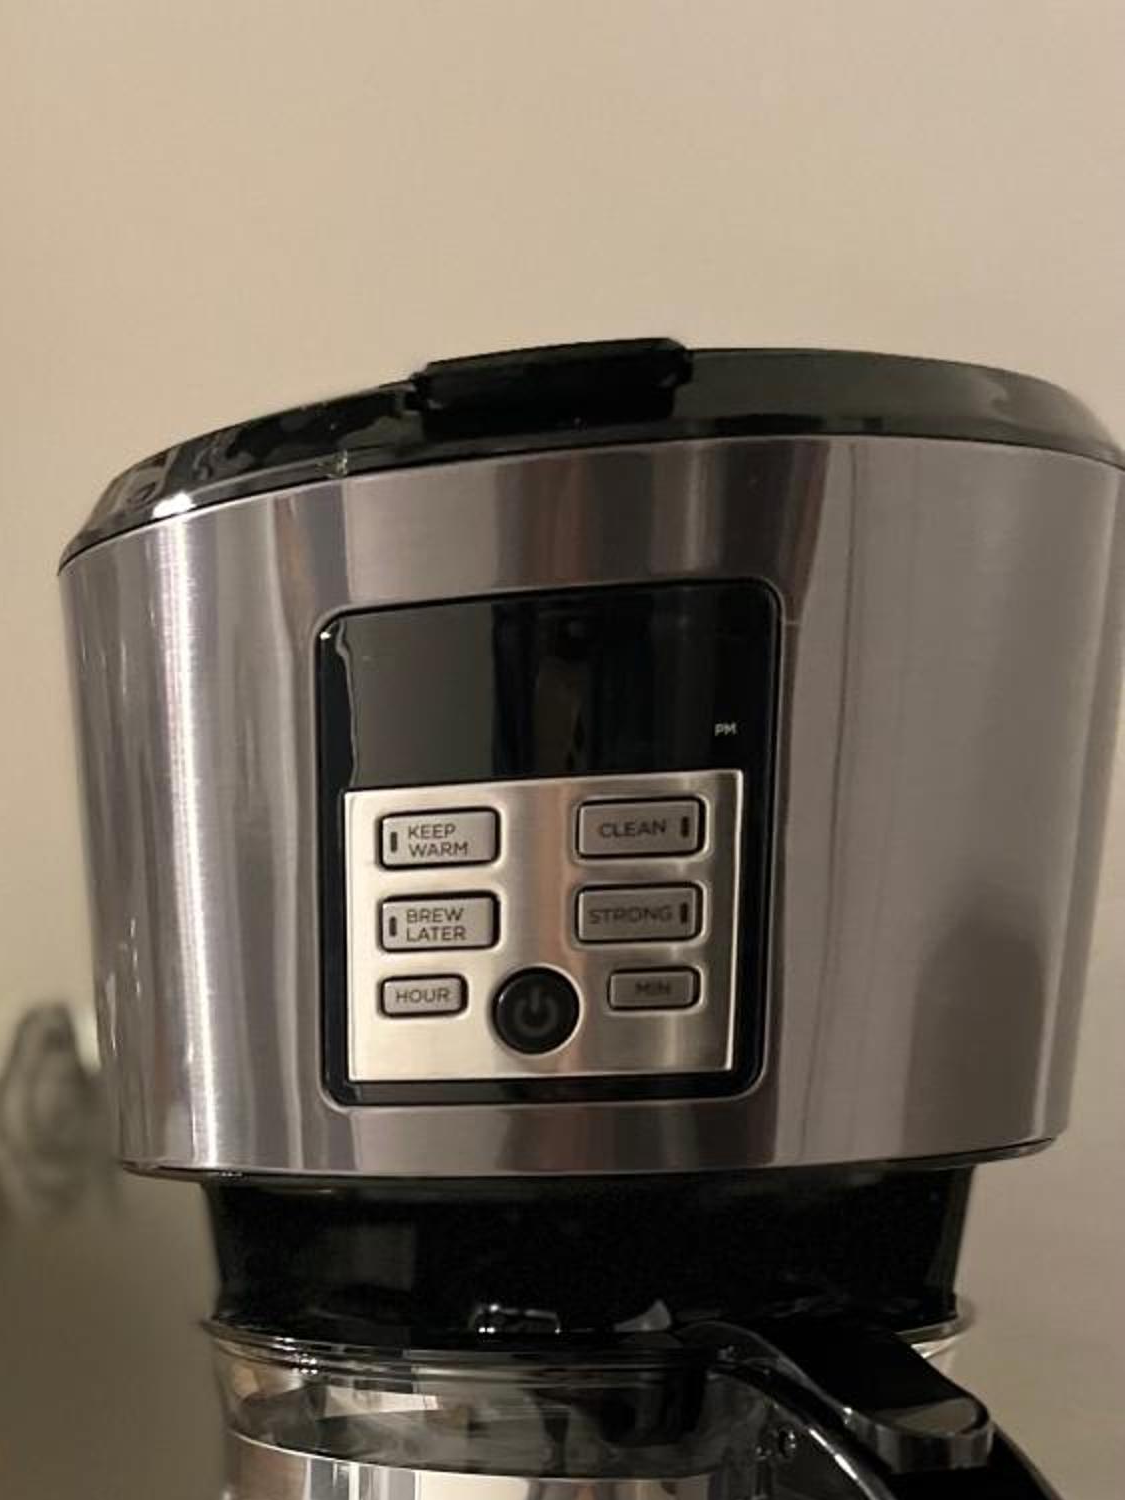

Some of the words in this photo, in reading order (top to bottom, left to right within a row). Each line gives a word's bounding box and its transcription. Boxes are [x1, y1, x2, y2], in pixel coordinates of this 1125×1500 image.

[714, 722, 737, 736] PM
[407, 823, 456, 841] KEEP
[599, 818, 667, 839] CLEAN
[408, 840, 469, 858] WARM
[406, 907, 465, 926] BREW
[588, 905, 673, 925] STRONG
[406, 925, 467, 943] LATER
[395, 987, 451, 1004] HOUR
